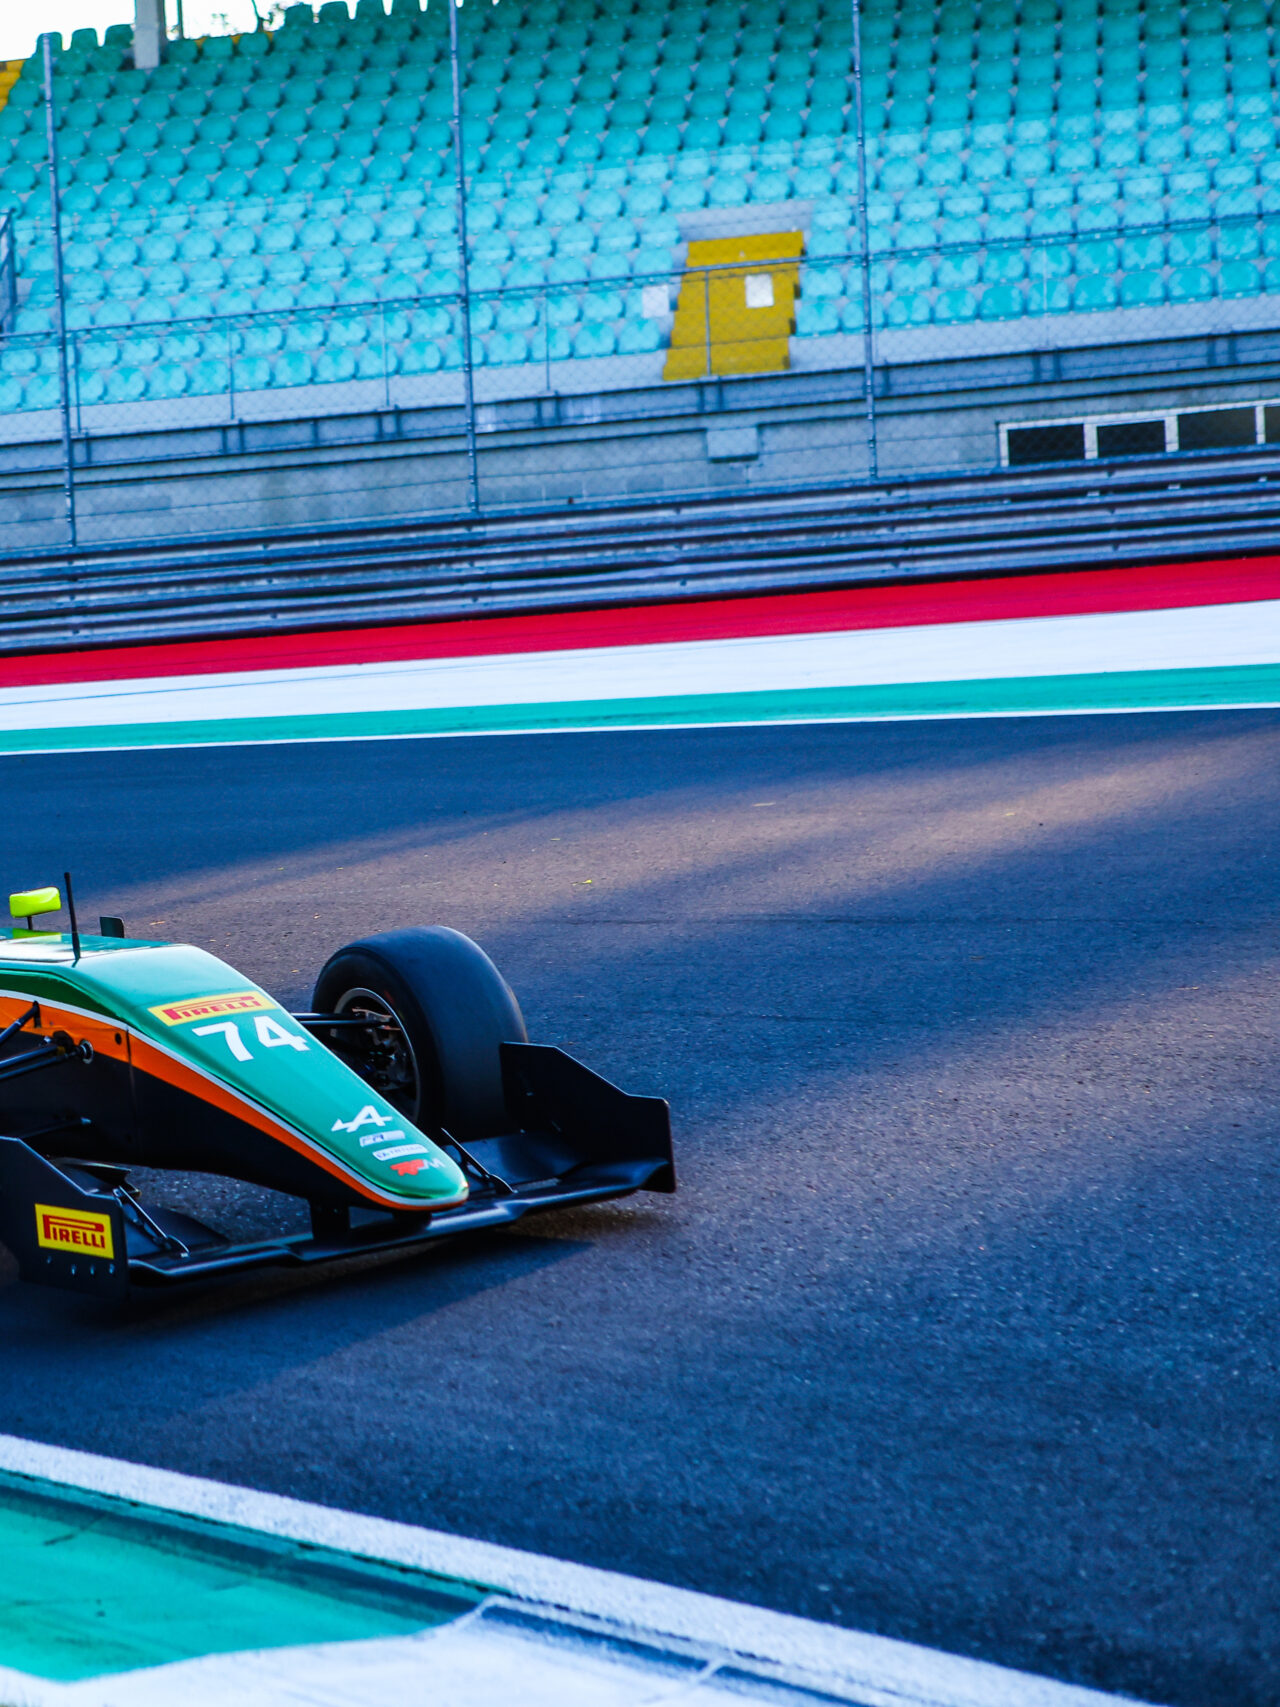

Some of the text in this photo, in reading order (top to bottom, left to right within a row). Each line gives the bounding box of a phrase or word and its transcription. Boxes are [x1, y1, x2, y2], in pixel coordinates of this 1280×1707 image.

[162, 995, 262, 1021] PIRELLI
[191, 1015, 312, 1062] 74
[42, 1213, 106, 1250] PIRELLI
